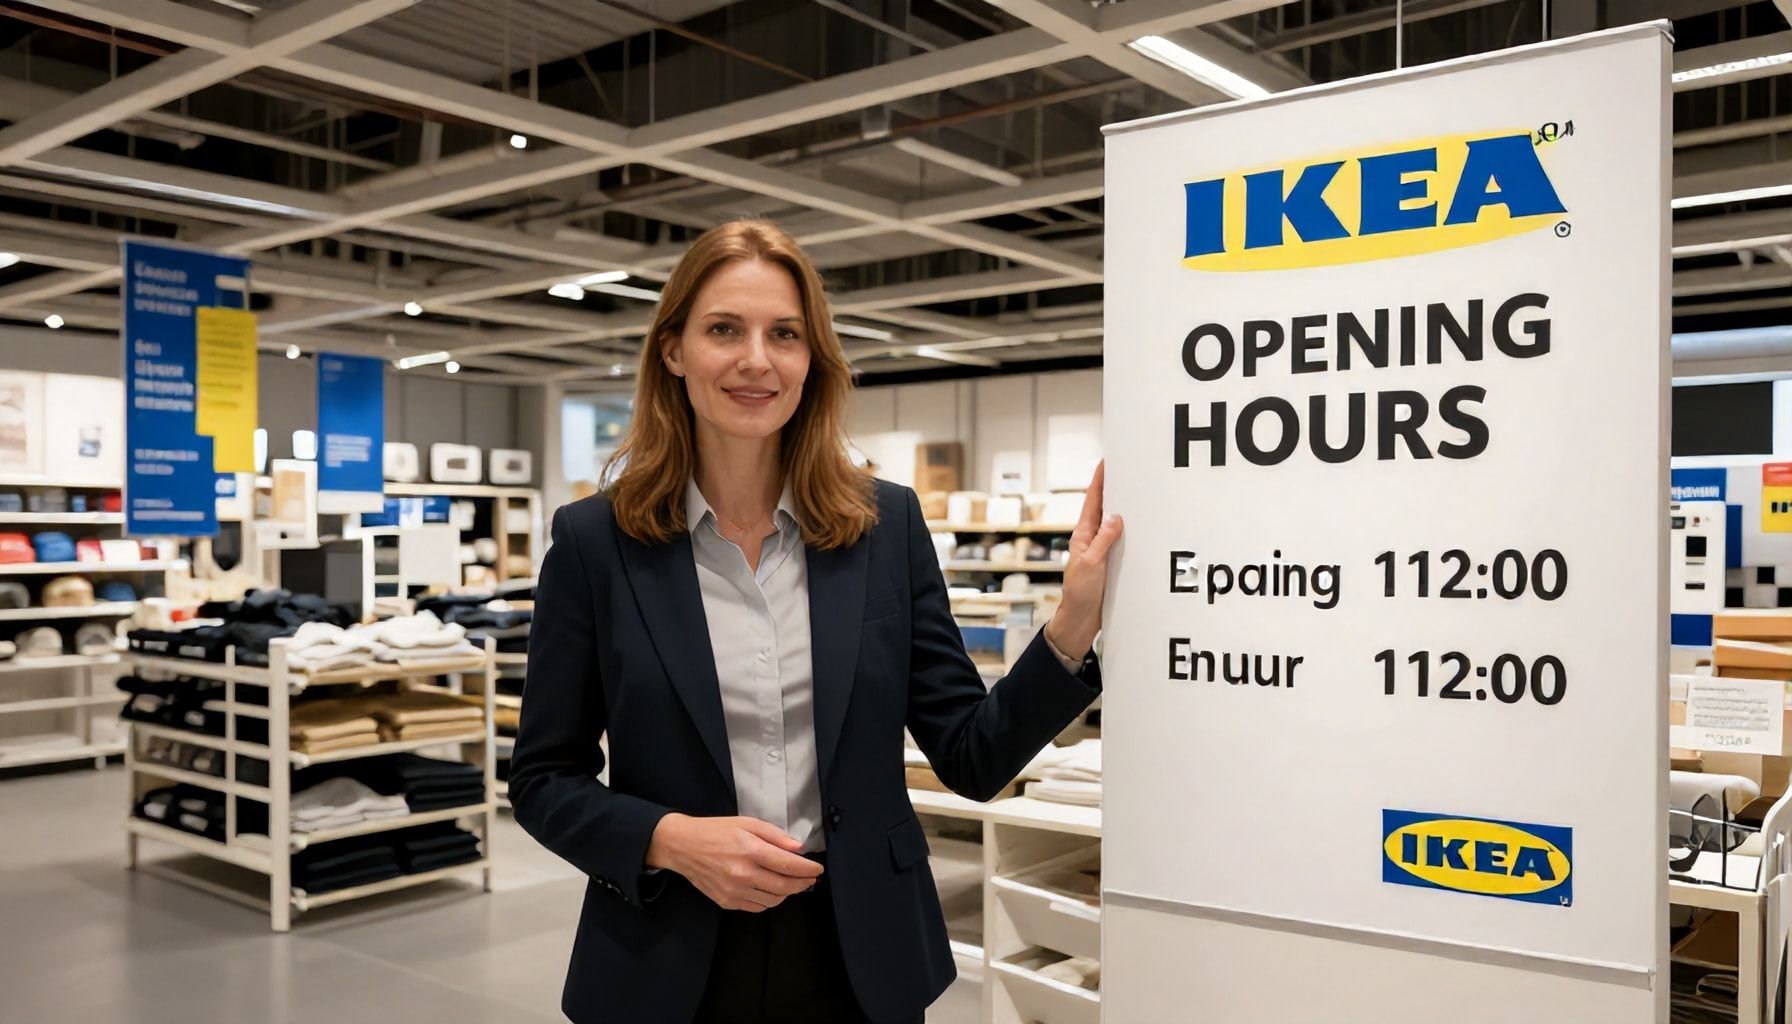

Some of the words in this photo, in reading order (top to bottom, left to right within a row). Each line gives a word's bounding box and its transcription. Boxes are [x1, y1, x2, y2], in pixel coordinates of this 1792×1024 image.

[1184, 135, 1568, 259] IKEA
[1181, 292, 1551, 382] OPENING
[1173, 384, 1490, 468] HOURS
[1374, 548, 1568, 601] 112:00
[1374, 649, 1567, 706] 112:00
[1402, 832, 1556, 881] IKEA
